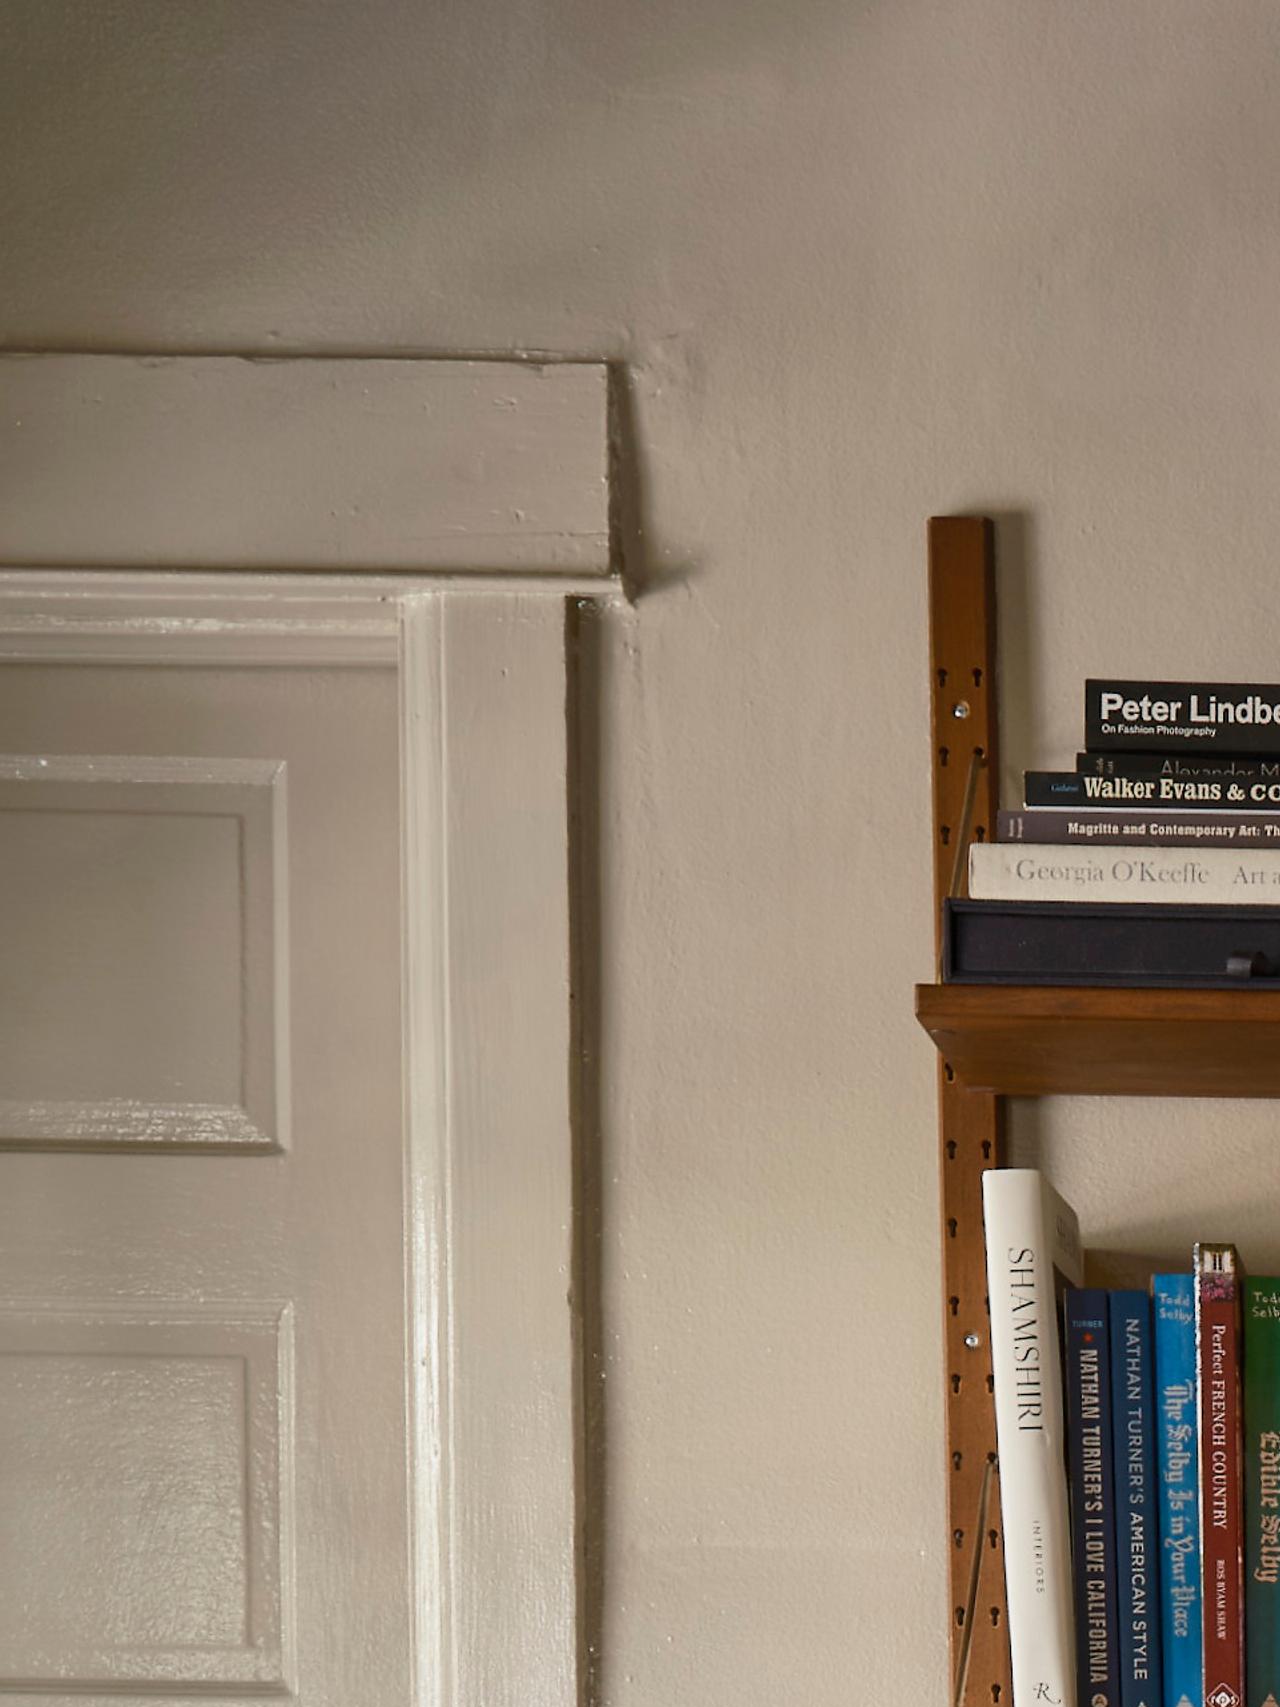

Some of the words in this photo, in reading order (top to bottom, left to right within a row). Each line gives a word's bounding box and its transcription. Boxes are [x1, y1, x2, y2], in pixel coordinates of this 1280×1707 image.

[1101, 693, 1181, 721] Peter
[1102, 724, 1115, 735] On
[1118, 725, 1154, 736] Fashion
[1156, 726, 1216, 738] Photography
[1084, 777, 1155, 799] Walker
[1161, 779, 1221, 800] Evans
[1228, 783, 1246, 801] &
[1068, 822, 1119, 838] Magritte
[1122, 824, 1144, 837] and
[1150, 824, 1235, 840] Contemporary
[1238, 825, 1261, 839] Art:
[1008, 1246, 1043, 1431] SHAMSHIRI
[1125, 1318, 1142, 1399] NATHAN
[1211, 1323, 1227, 1376] Perfect
[1079, 1349, 1099, 1419] NATHAN
[1211, 1379, 1227, 1447] FRENCH
[1082, 1425, 1103, 1512] TURNER'S
[1127, 1407, 1144, 1504] TURNER'S
[1211, 1449, 1228, 1529] COUNTRY
[1086, 1531, 1105, 1572] LOVE
[1129, 1511, 1147, 1616] AMERICAN
[1086, 1579, 1109, 1683] CALIFORNIA
[1132, 1620, 1148, 1679] STYLE
